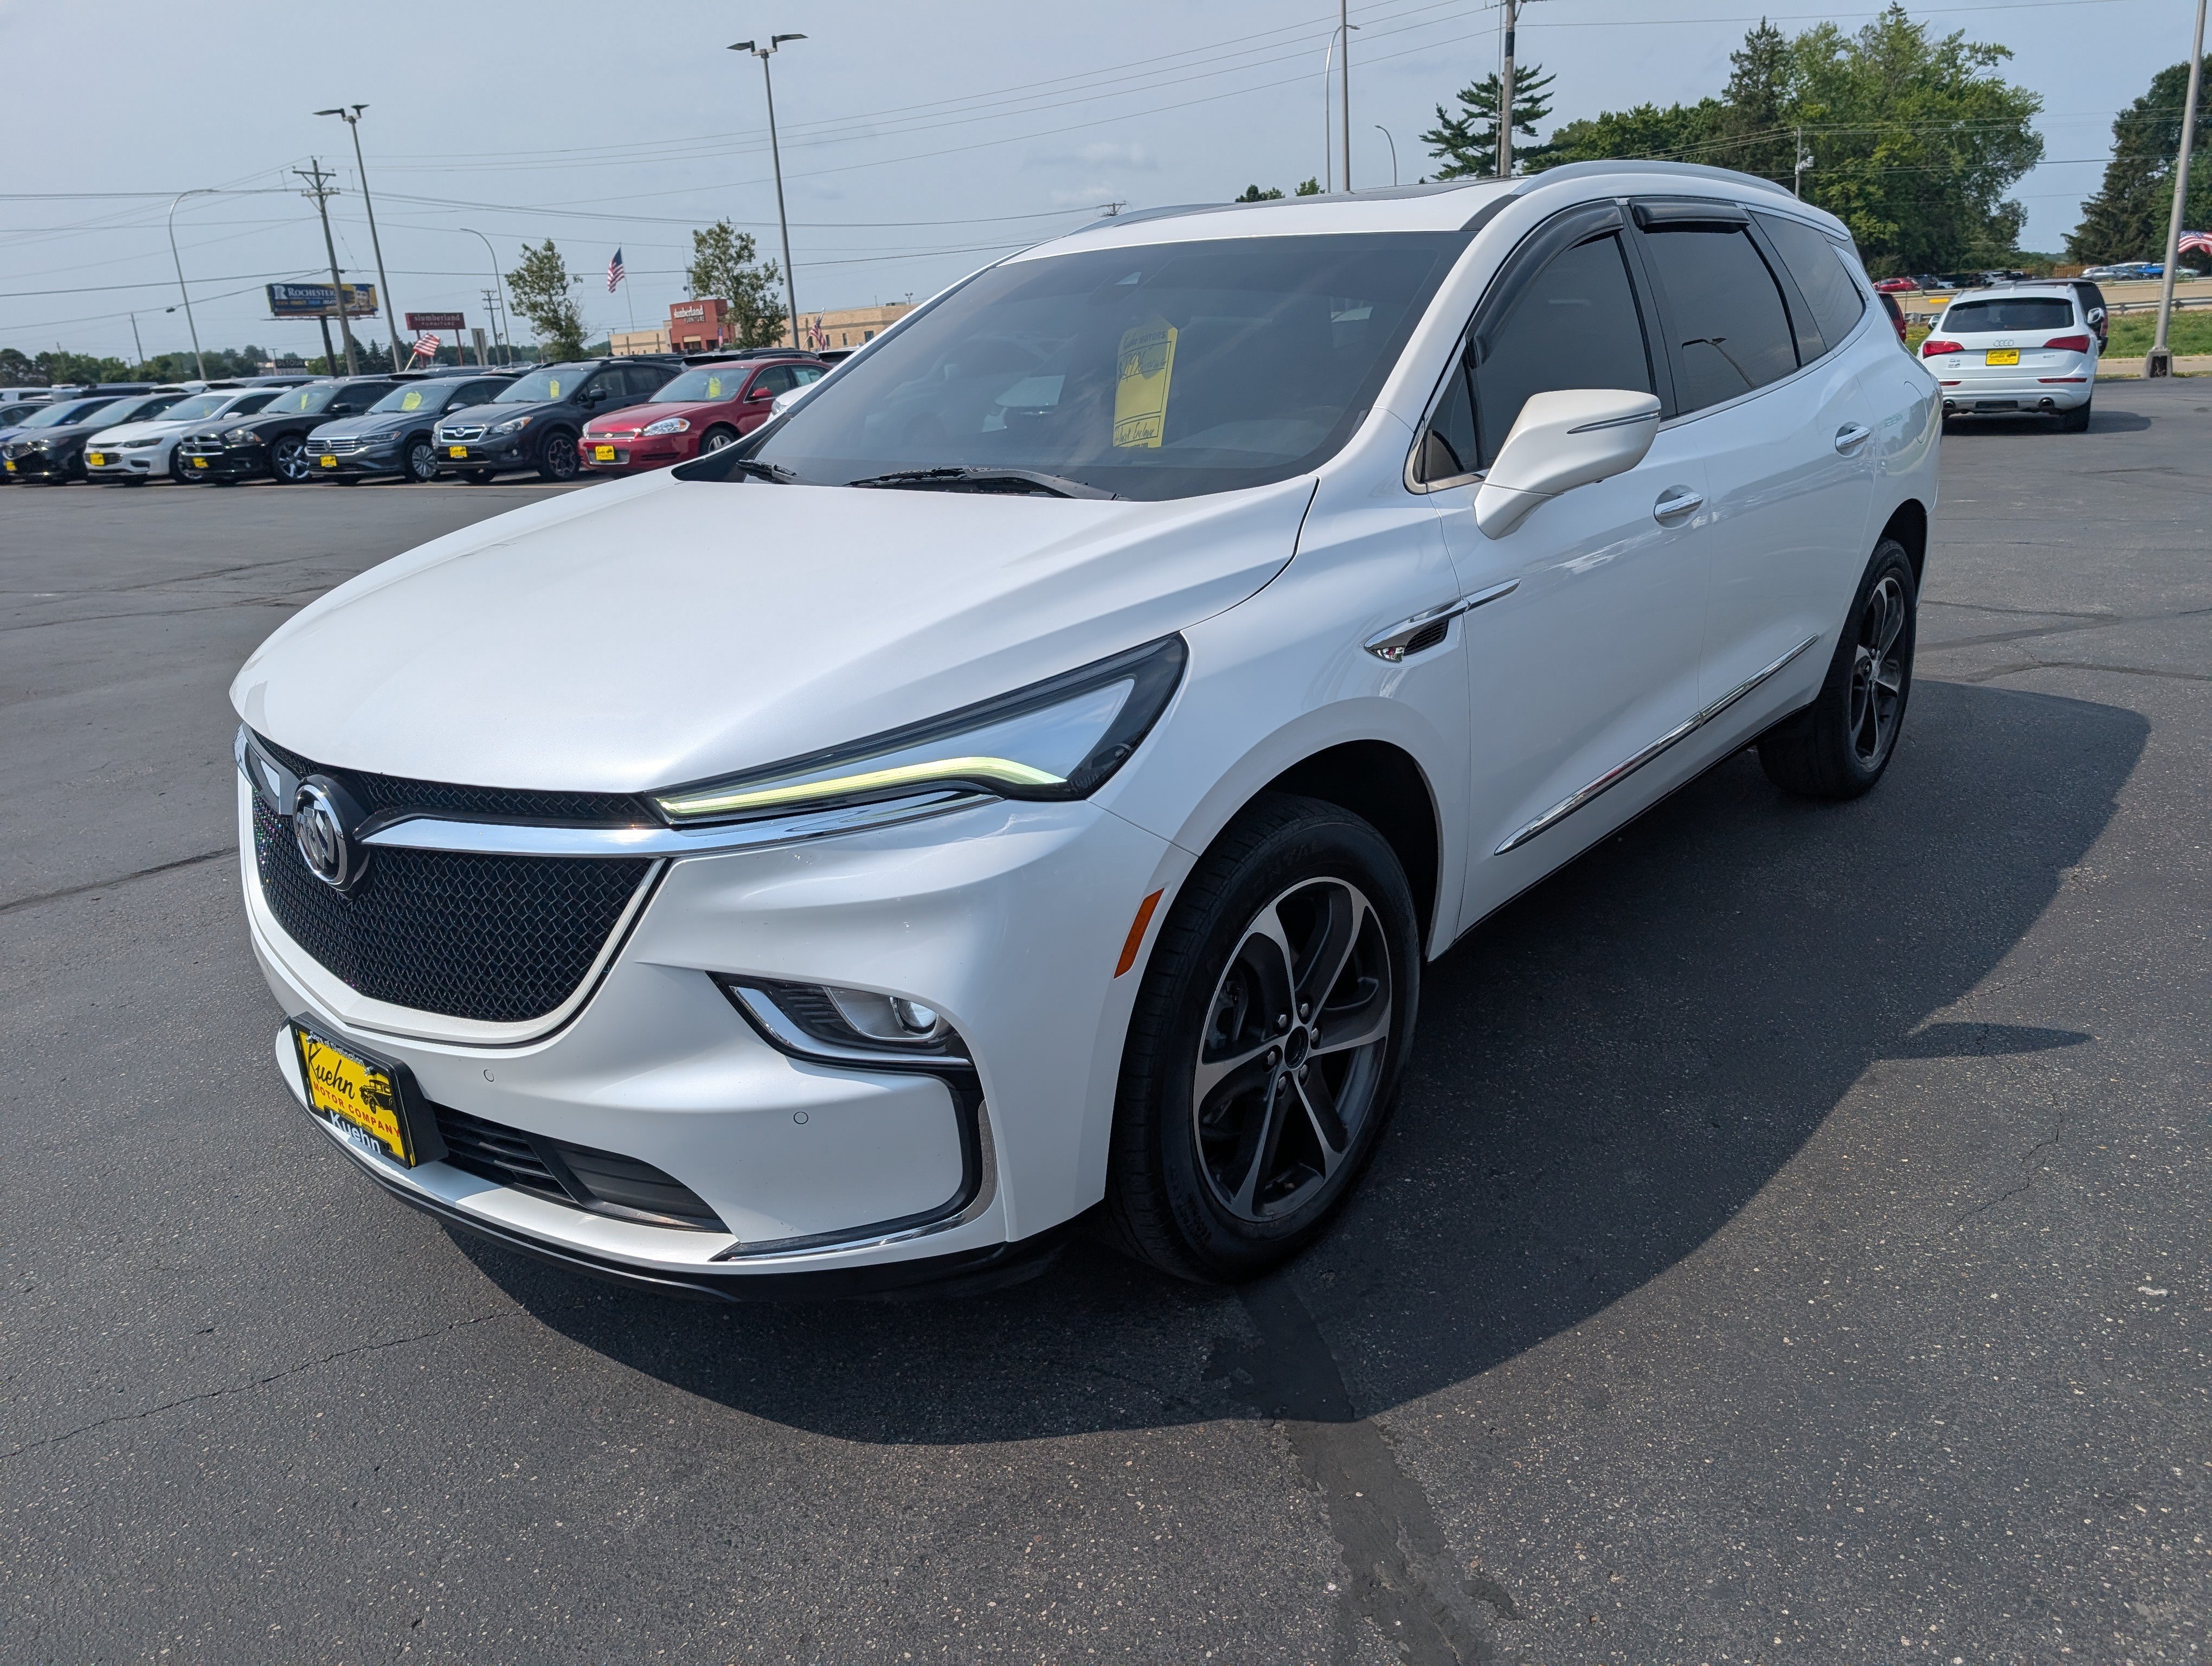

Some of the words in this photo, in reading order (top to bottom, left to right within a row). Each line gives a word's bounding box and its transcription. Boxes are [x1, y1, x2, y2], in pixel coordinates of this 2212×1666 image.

[307, 1042, 356, 1100] Kuehn
[313, 1080, 345, 1108] MOTOR
[348, 1104, 401, 1138] COMPANY
[330, 1110, 381, 1155] Kuehn
